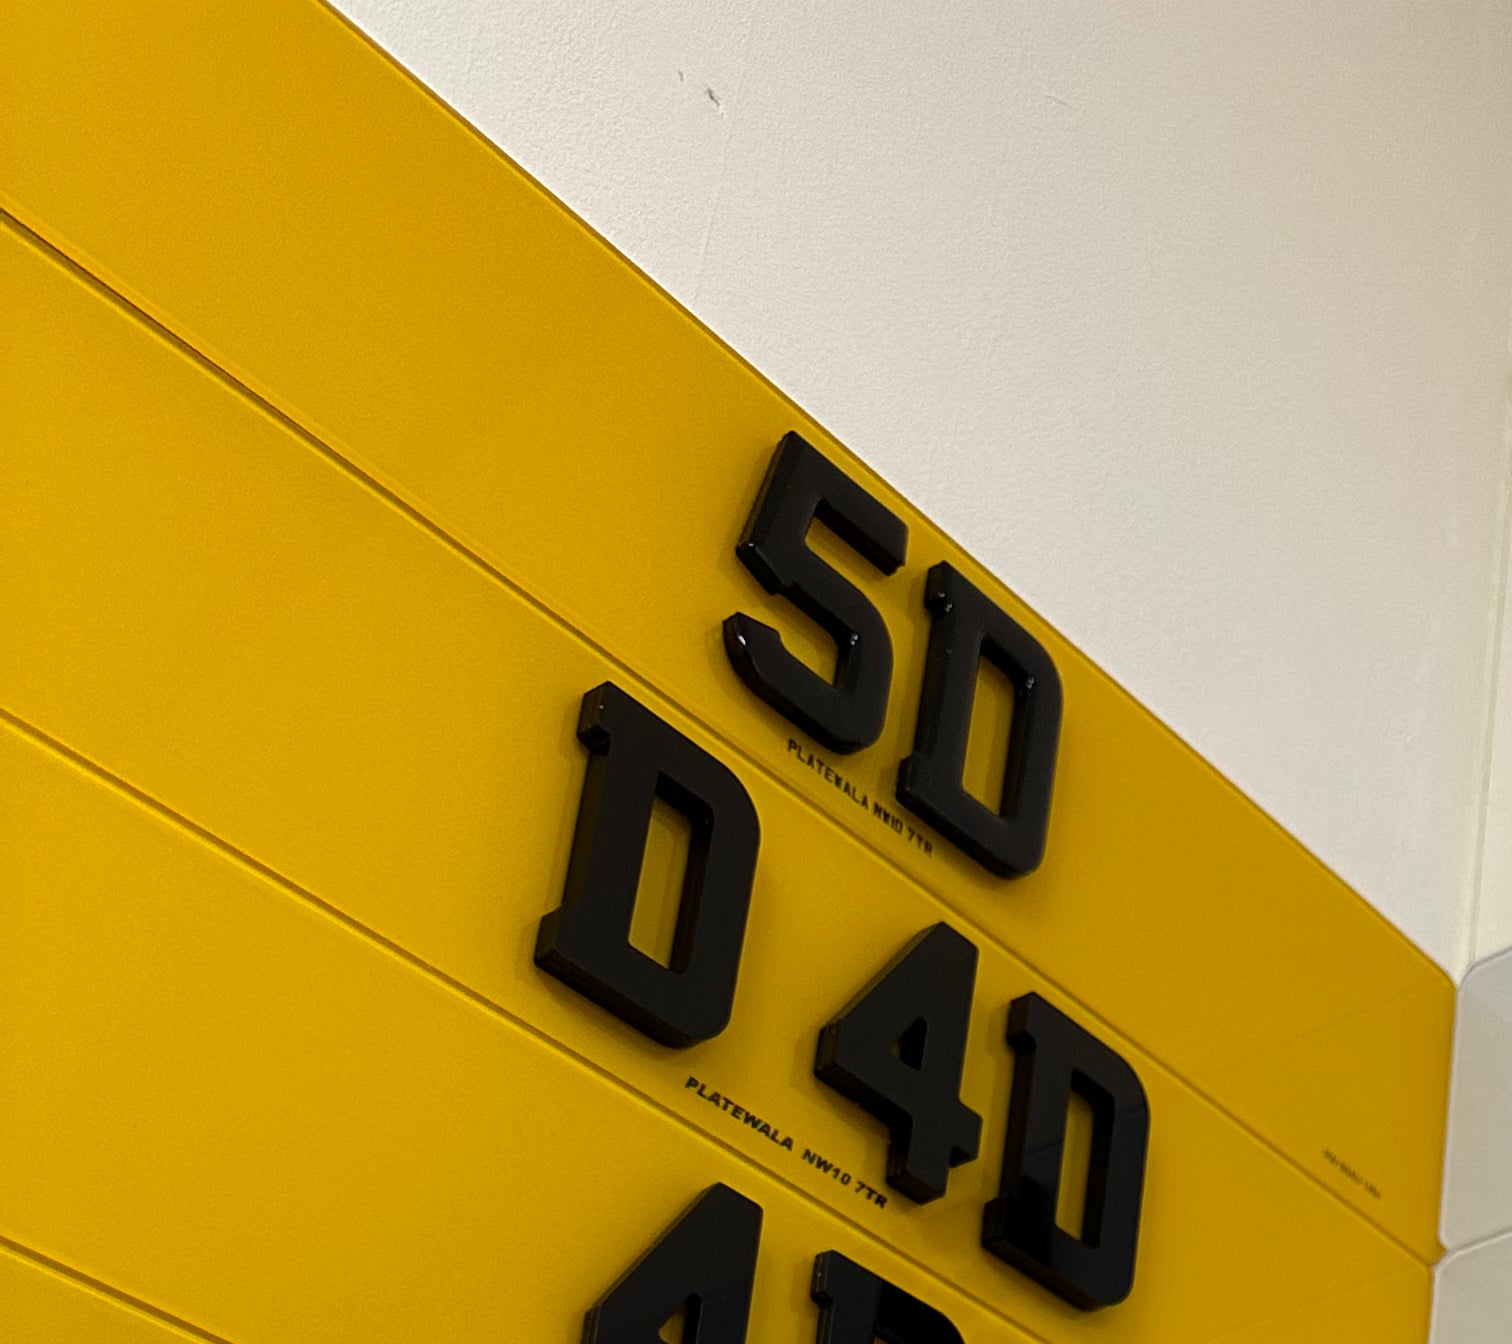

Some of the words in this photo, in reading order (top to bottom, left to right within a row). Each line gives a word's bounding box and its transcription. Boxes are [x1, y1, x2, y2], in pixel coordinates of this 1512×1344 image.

[722, 431, 1065, 879] 5D
[787, 738, 869, 811] PLATEWALA
[907, 825, 934, 857] 7TR
[534, 680, 761, 1051] D
[813, 920, 1151, 1313] 4D
[685, 1076, 795, 1152] PLATEWALA
[801, 1148, 852, 1186] NW10
[855, 1180, 889, 1209] 7TR
